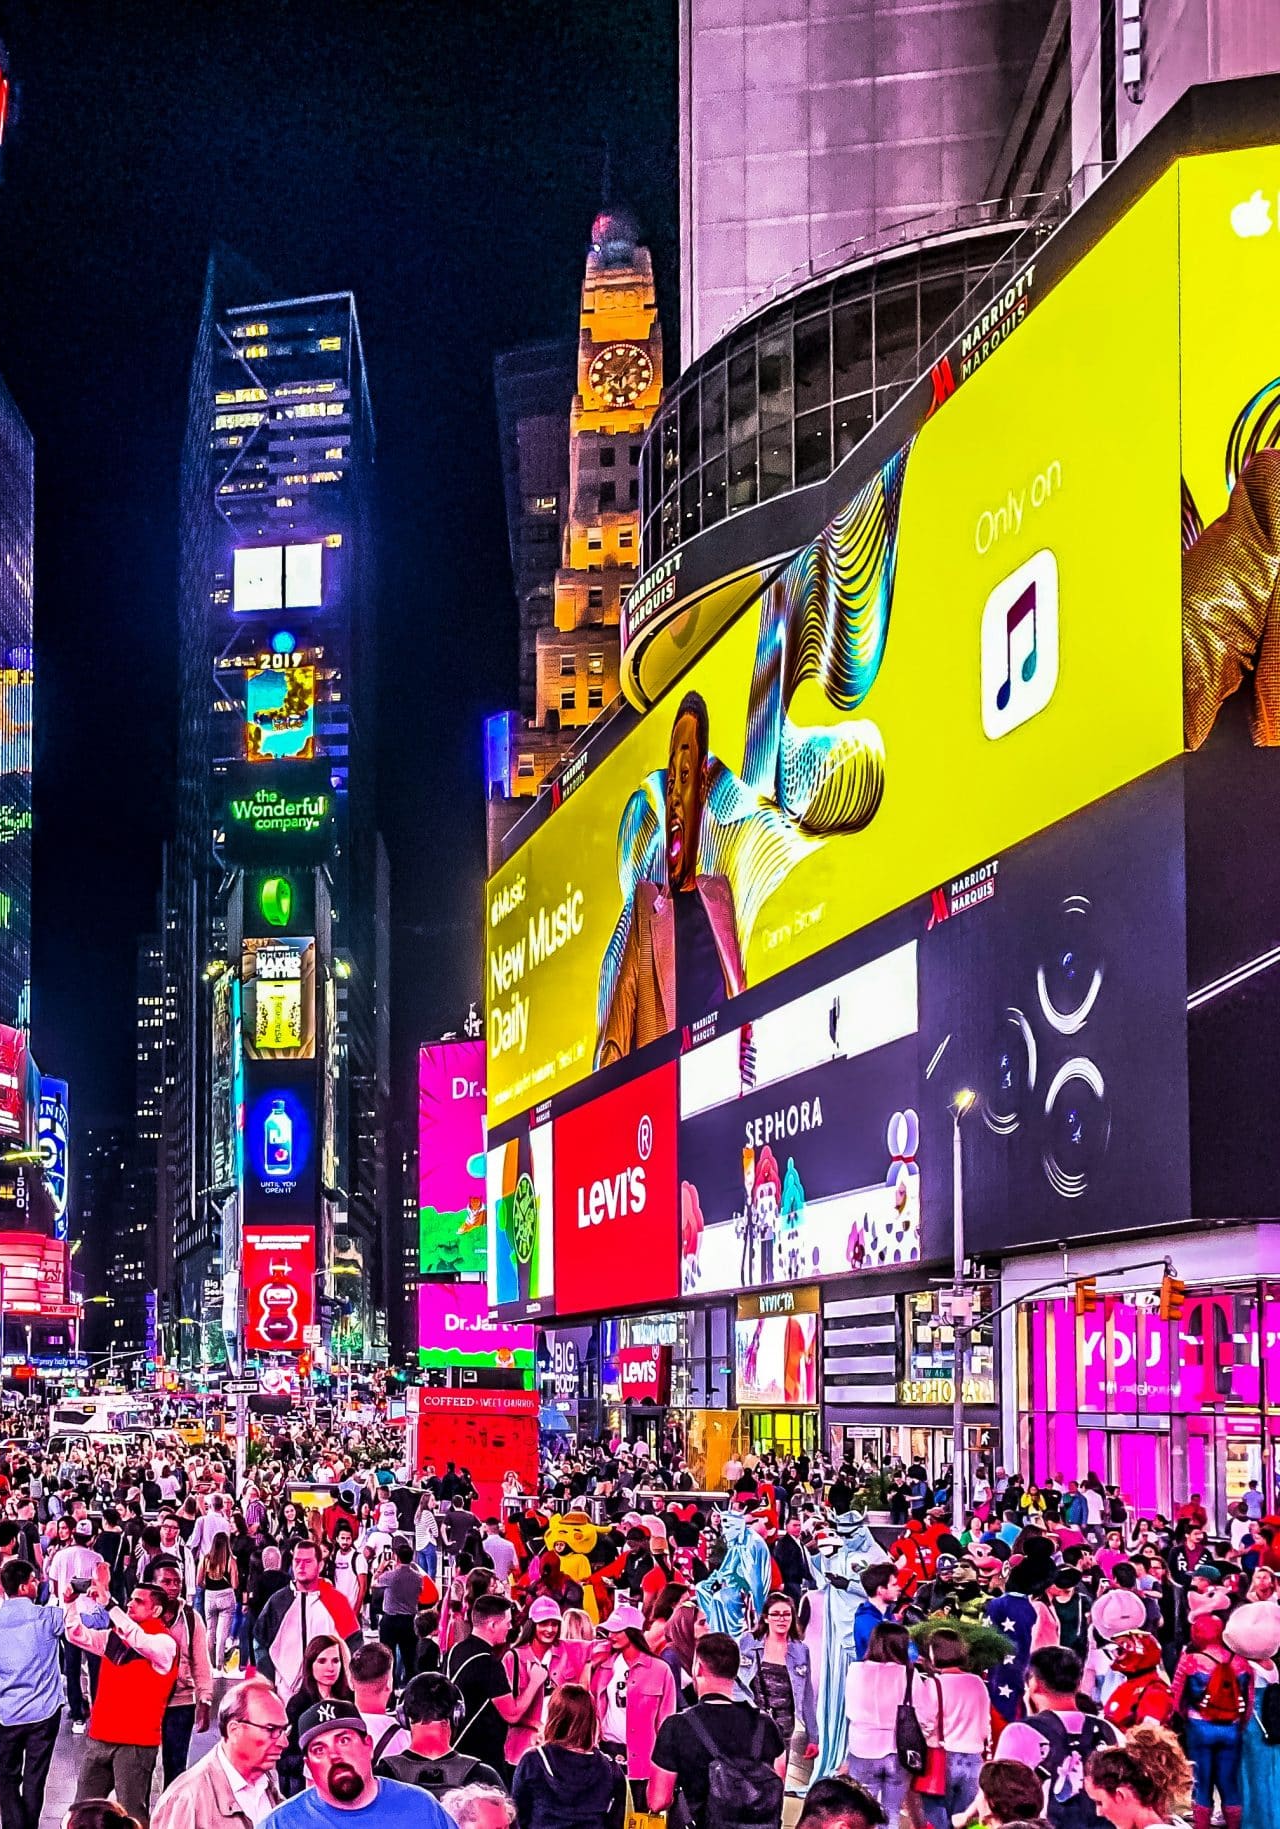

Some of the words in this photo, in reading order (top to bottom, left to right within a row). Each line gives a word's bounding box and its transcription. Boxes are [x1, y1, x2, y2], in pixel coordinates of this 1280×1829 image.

[962, 265, 1035, 357] MARRIOTT
[961, 302, 1026, 380] MARQUIS
[974, 488, 1025, 555] Only
[1030, 459, 1062, 508] on
[628, 552, 683, 614] MARRIOTT
[628, 581, 674, 637] MARQUIS
[260, 653, 303, 669] 2019
[232, 796, 325, 818] Wonderful
[255, 789, 278, 802] the
[255, 815, 311, 832] company
[490, 937, 525, 995] New
[528, 882, 584, 971] Music
[490, 991, 529, 1060] Daily
[692, 1011, 719, 1031] MARRIOTT
[692, 1026, 716, 1045] MARQUIS
[745, 1097, 823, 1148] SEPHORA
[16, 1166, 25, 1208] 1500
[759, 1292, 795, 1314] INVICTA
[554, 1341, 575, 1373] BIG
[1083, 1331, 1161, 1368] YOU
[424, 1396, 475, 1406] COFFEED
[316, 1703, 337, 1722] NY
